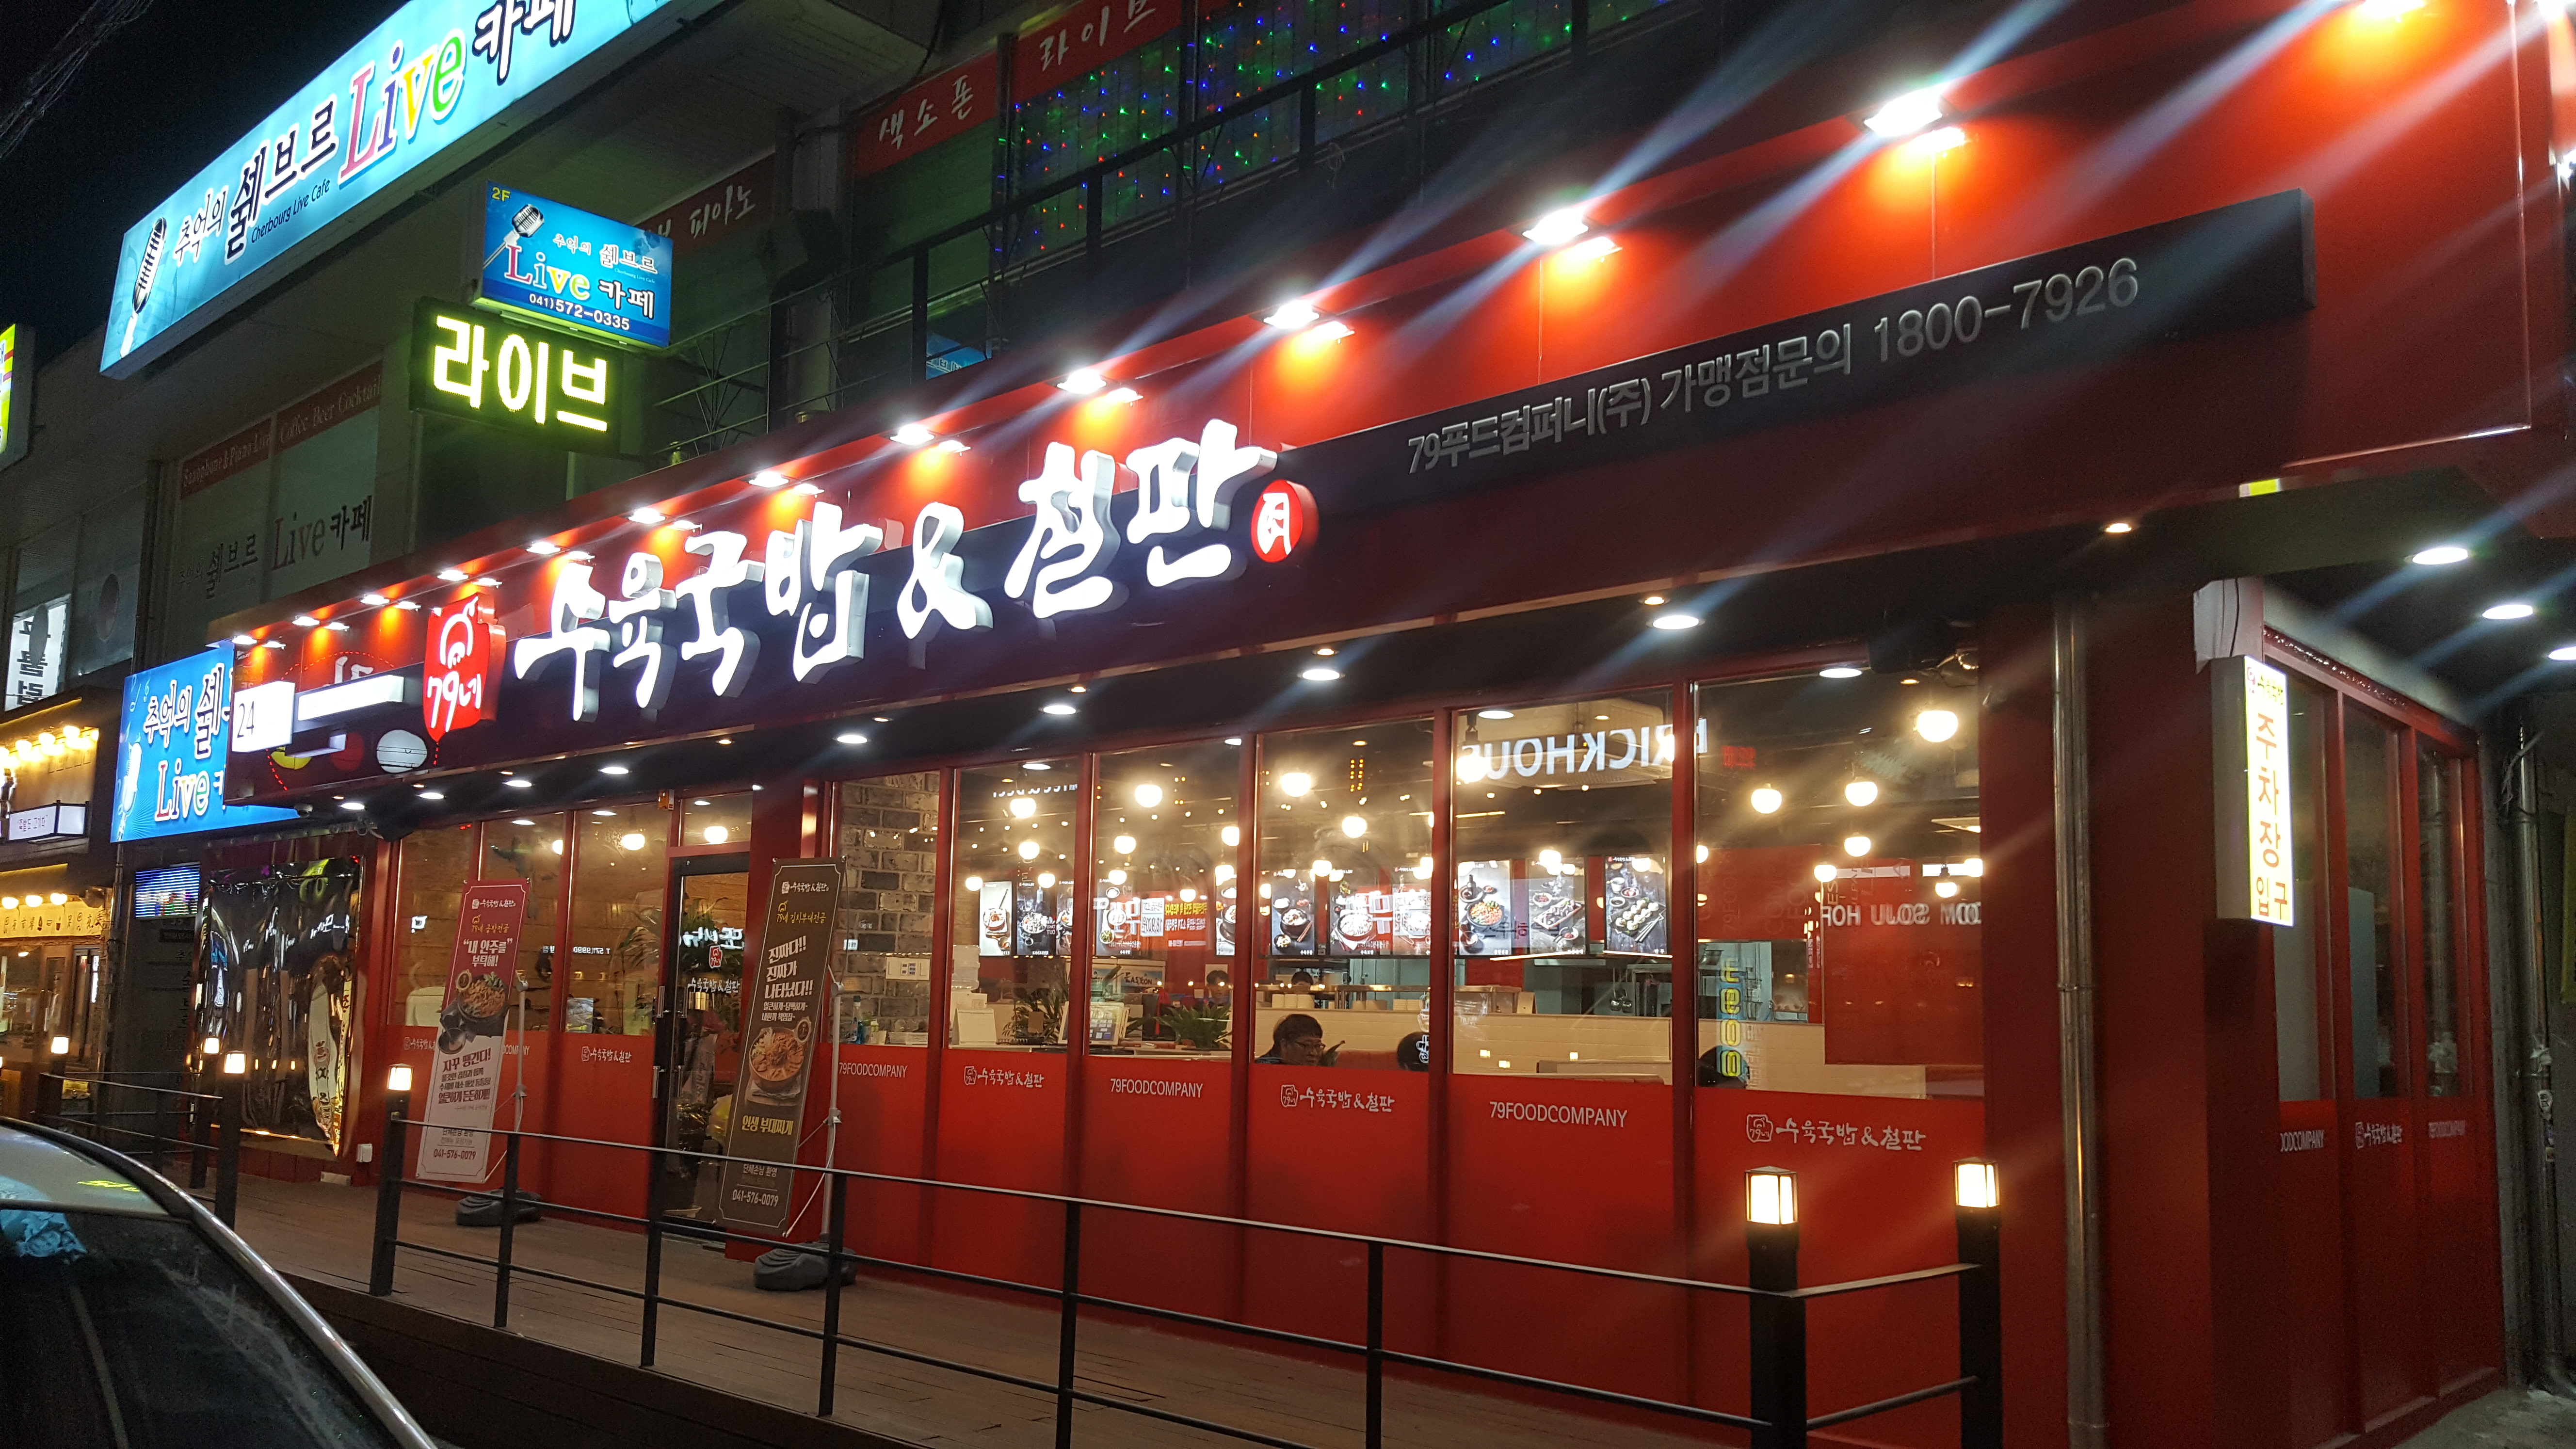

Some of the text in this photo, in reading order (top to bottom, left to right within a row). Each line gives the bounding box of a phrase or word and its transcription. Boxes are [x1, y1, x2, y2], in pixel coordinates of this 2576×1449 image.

[878, 75, 974, 150] 색소폰
[174, 189, 227, 263] 추억의
[226, 99, 337, 259] 쉘브르
[339, 32, 464, 182] Live
[251, 178, 331, 243] Cherbourg Live Cafe
[491, 187, 511, 202] 2F
[689, 185, 757, 239] 피아노
[553, 233, 658, 274] 추억의 쉘브르
[505, 243, 655, 320] Live 카페
[529, 293, 630, 331] 041)572-0335
[434, 315, 608, 432] 라이브
[1407, 257, 2138, 475] 79푸드컴퍼니(주) 가맹점문의 1800-7926
[271, 511, 326, 572] Live
[330, 495, 372, 551] 카페
[514, 418, 1277, 722] 수육국밥 & 철판
[143, 662, 230, 759] 추억의 쉘
[237, 700, 255, 739] 24
[154, 757, 210, 821] Live
[2255, 712, 2288, 921] 주차장 입구
[687, 976, 717, 993] 수육국밥
[724, 978, 741, 994] 철판
[766, 960, 798, 983] 진짜가
[838, 1062, 907, 1079] 79FOODCOMPANY
[977, 1068, 1015, 1087] 수육국밥
[1023, 1073, 1045, 1089] 철판
[1110, 1078, 1203, 1098] 79FOODCOMPANY
[1299, 1087, 1352, 1110] 수육국밥
[1353, 1093, 1366, 1110] &
[1365, 1094, 1395, 1113] 철판
[1488, 1100, 1627, 1128] 79FOODCOMPANY
[433, 1148, 477, 1160] 041-576-0079
[1775, 1117, 1858, 1146] 수육국밥
[1861, 1126, 1880, 1147] &
[1880, 1125, 1927, 1152] 철판
[732, 1189, 779, 1208] 041-576-0079
